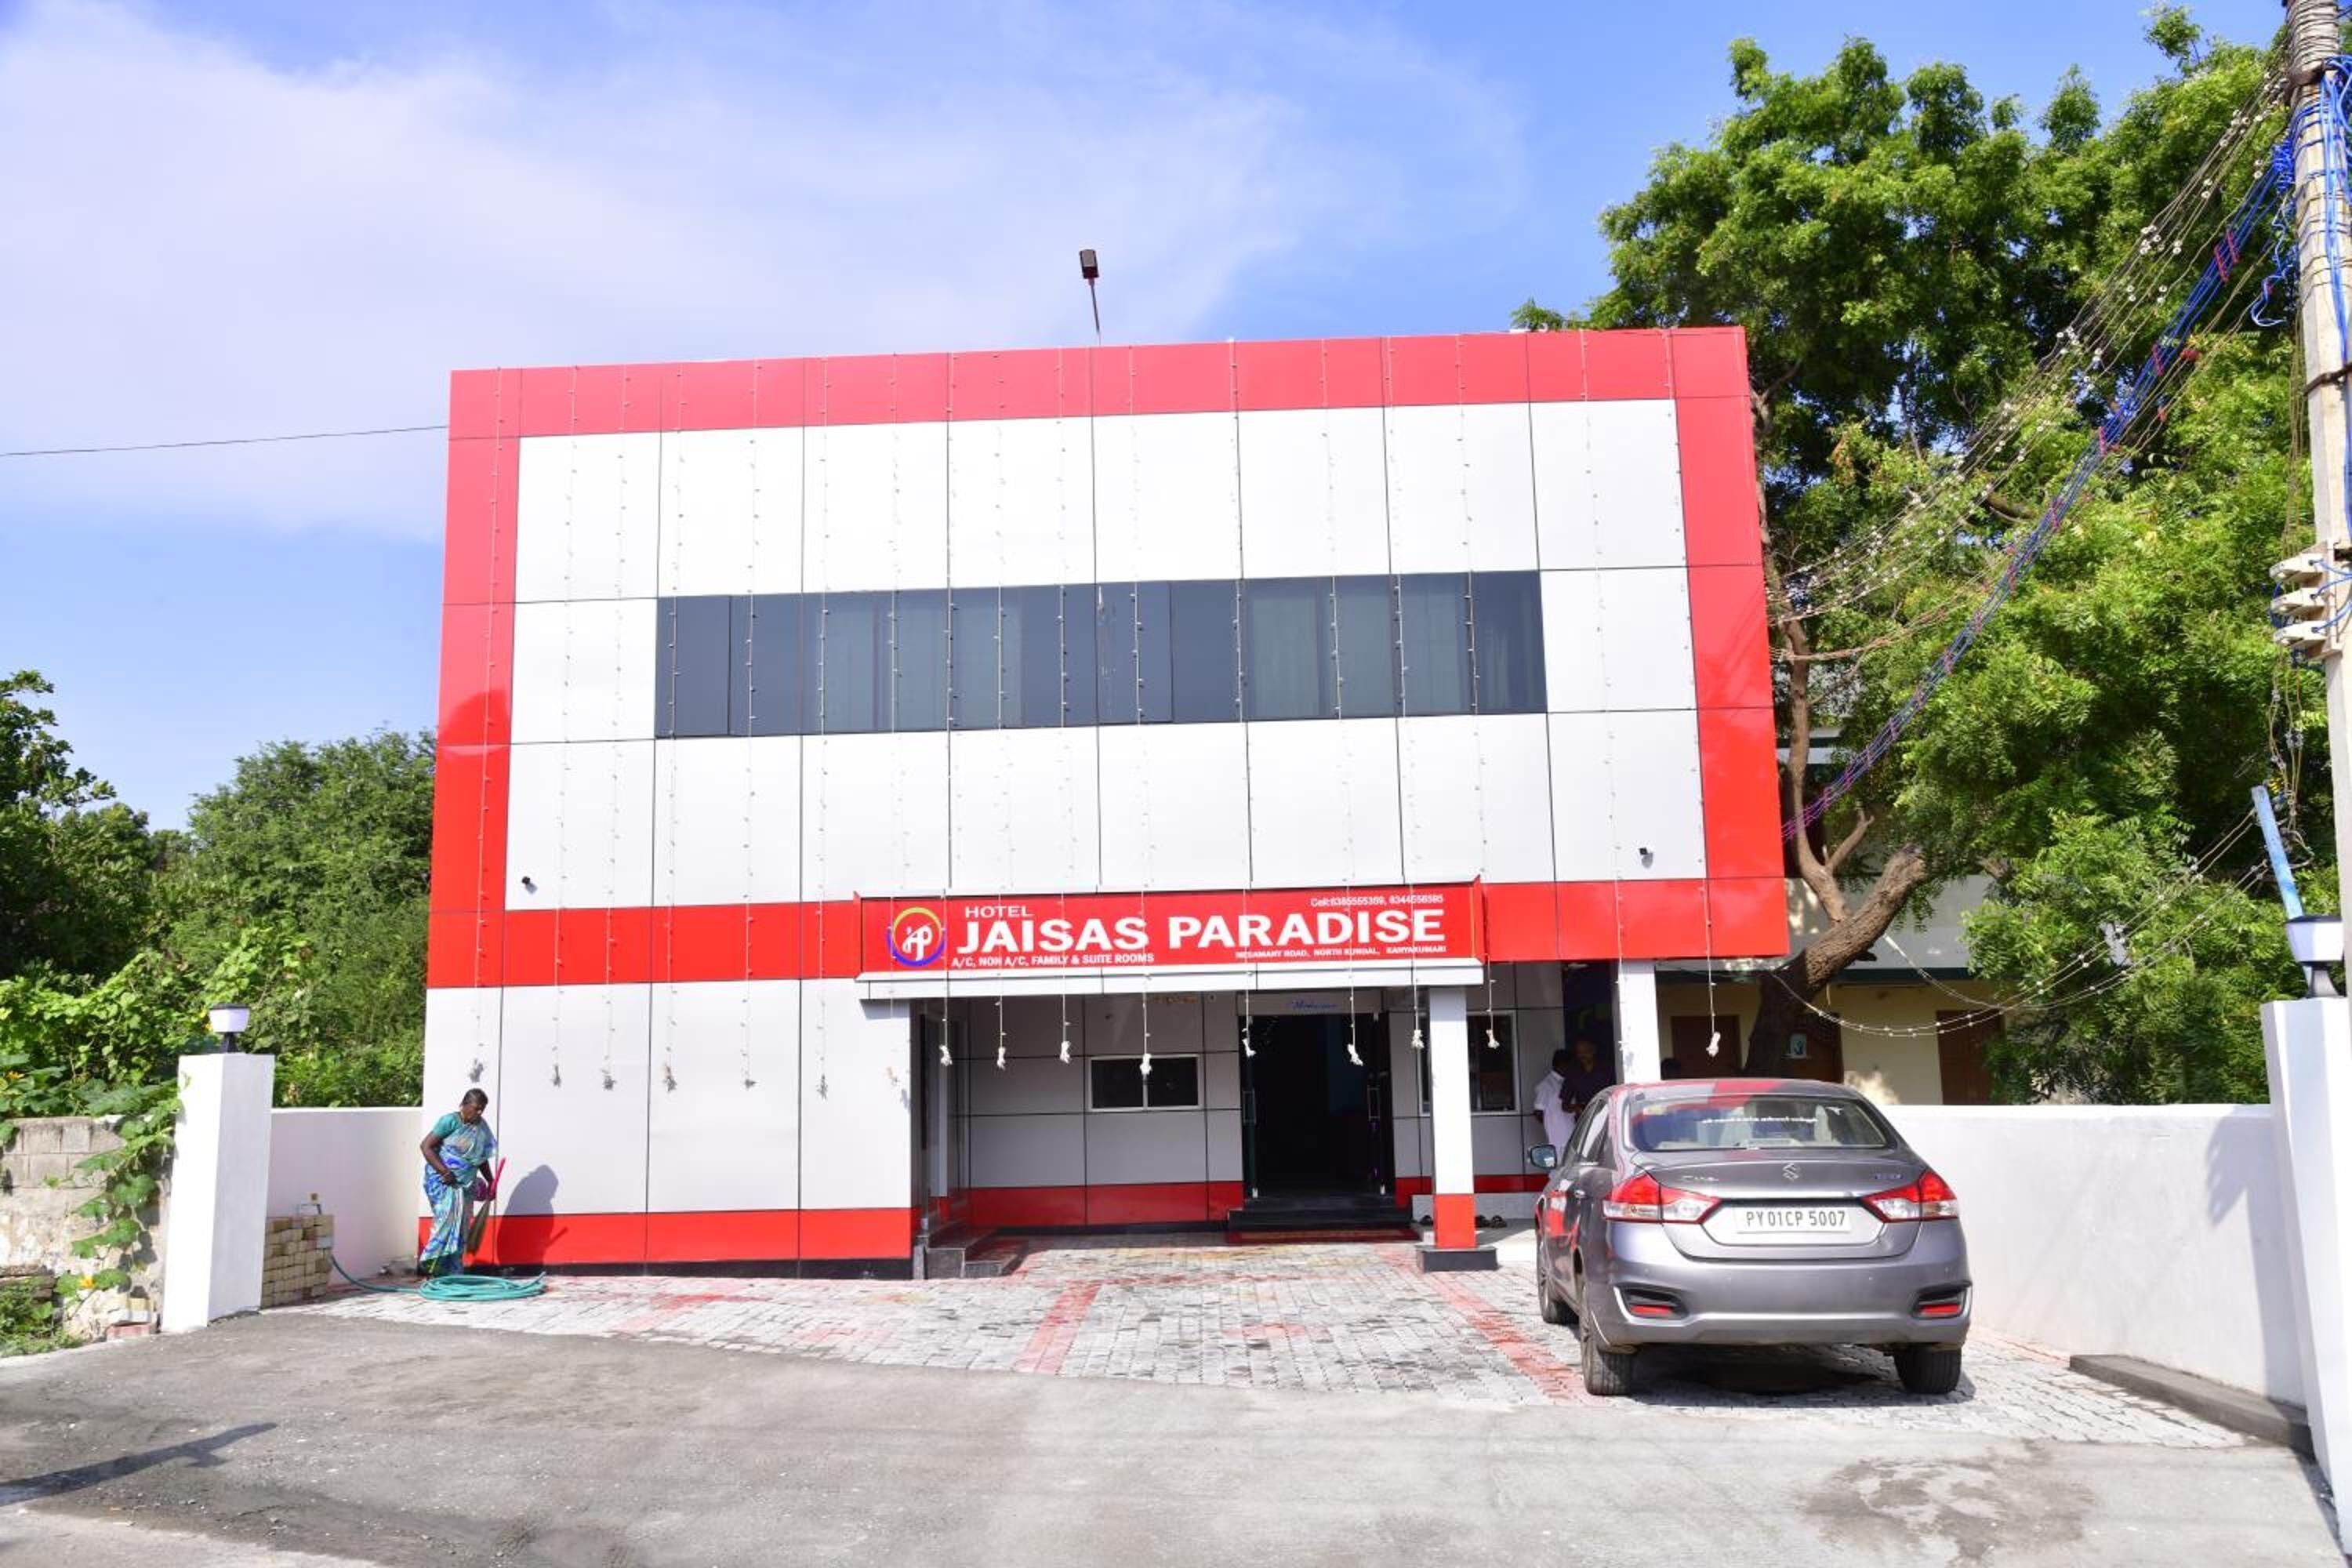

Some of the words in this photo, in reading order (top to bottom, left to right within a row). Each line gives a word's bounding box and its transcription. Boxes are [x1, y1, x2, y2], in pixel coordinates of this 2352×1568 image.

[965, 906, 1034, 918] HOTEL
[957, 916, 1149, 954] JAISAS
[1168, 909, 1446, 949] PARADISE
[1386, 946, 1446, 954] KANYAKUMARI
[978, 956, 1003, 966] NON
[1031, 955, 1067, 965] FAMILY
[1071, 955, 1080, 964] &
[1082, 954, 1112, 964] SUITE
[1114, 953, 1155, 964] ROOMS
[1809, 1210, 1846, 1226] 5007
